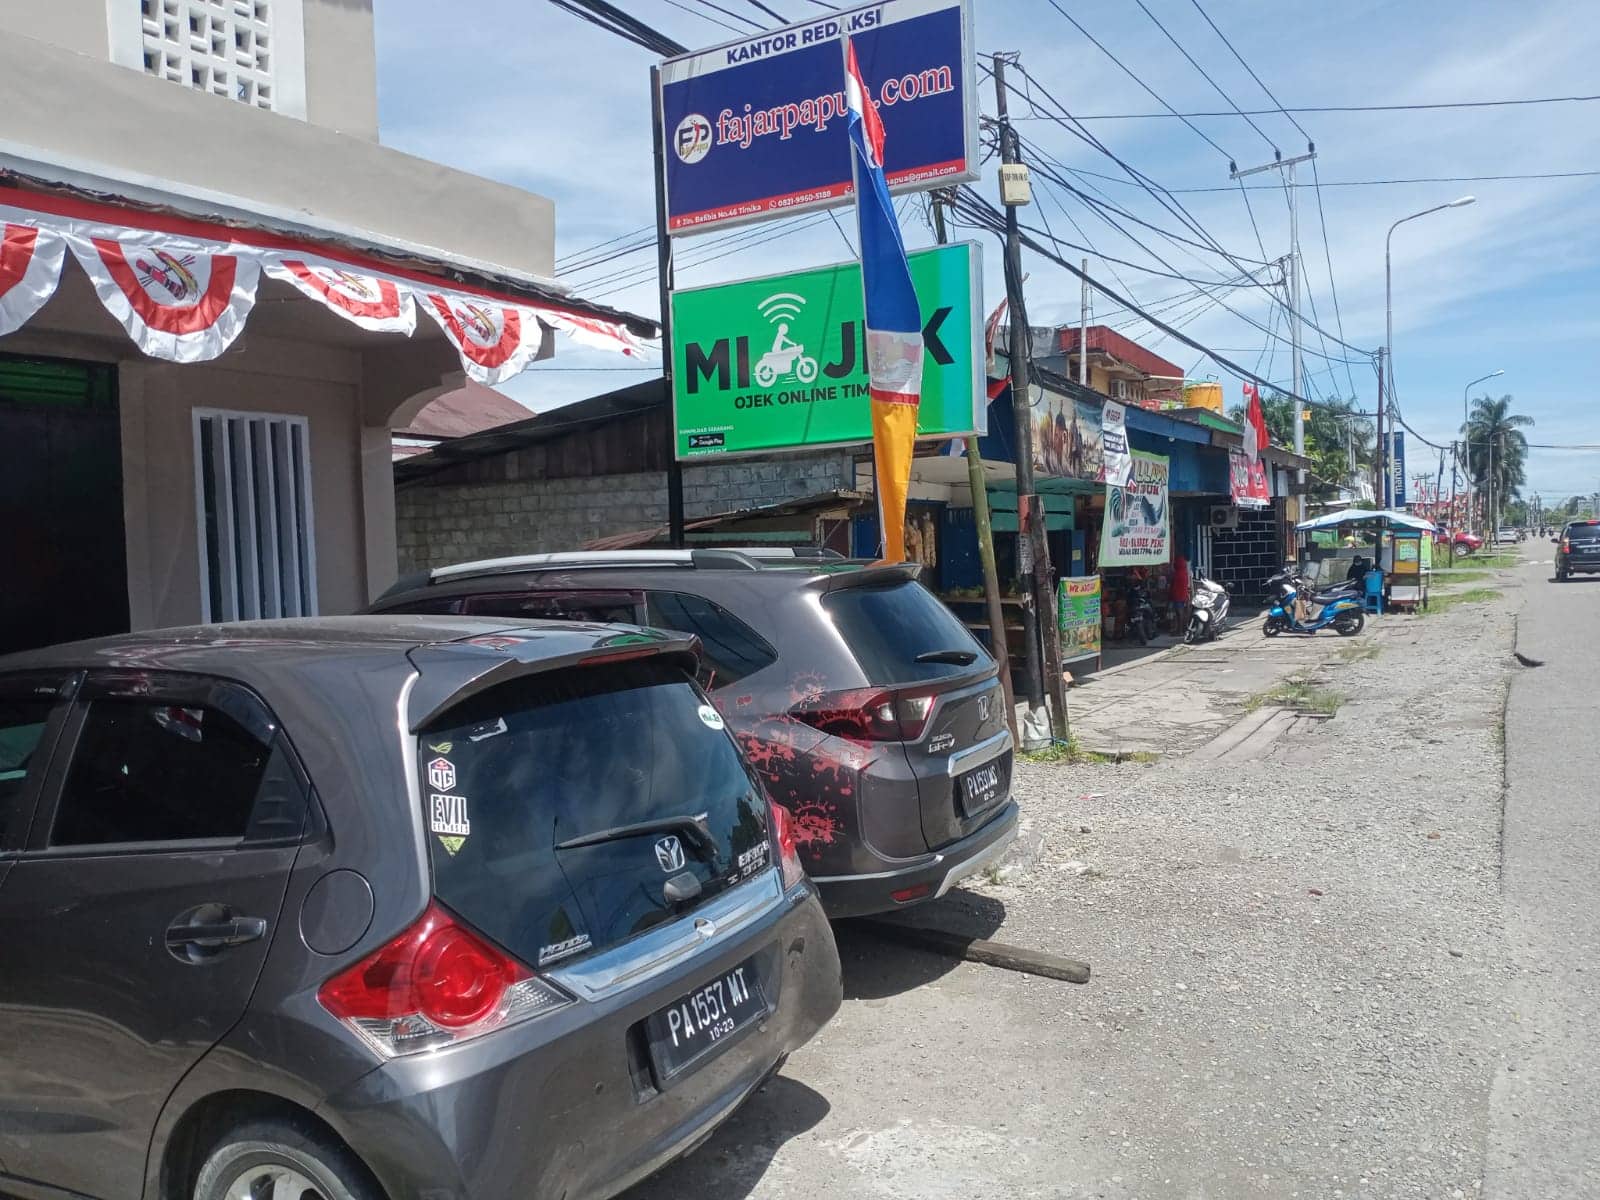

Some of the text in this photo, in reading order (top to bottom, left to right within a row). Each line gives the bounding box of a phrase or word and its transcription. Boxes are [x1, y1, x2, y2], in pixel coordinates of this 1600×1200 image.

[727, 33, 797, 64] KANTOR
[716, 65, 954, 149] fajarpapu.com
[739, 204, 762, 215] Timika
[686, 306, 955, 394] MI JK
[734, 382, 872, 409] OJEK ONLINE TIM
[432, 796, 468, 824] EVIL
[667, 968, 749, 1047] PA 1557 MT
